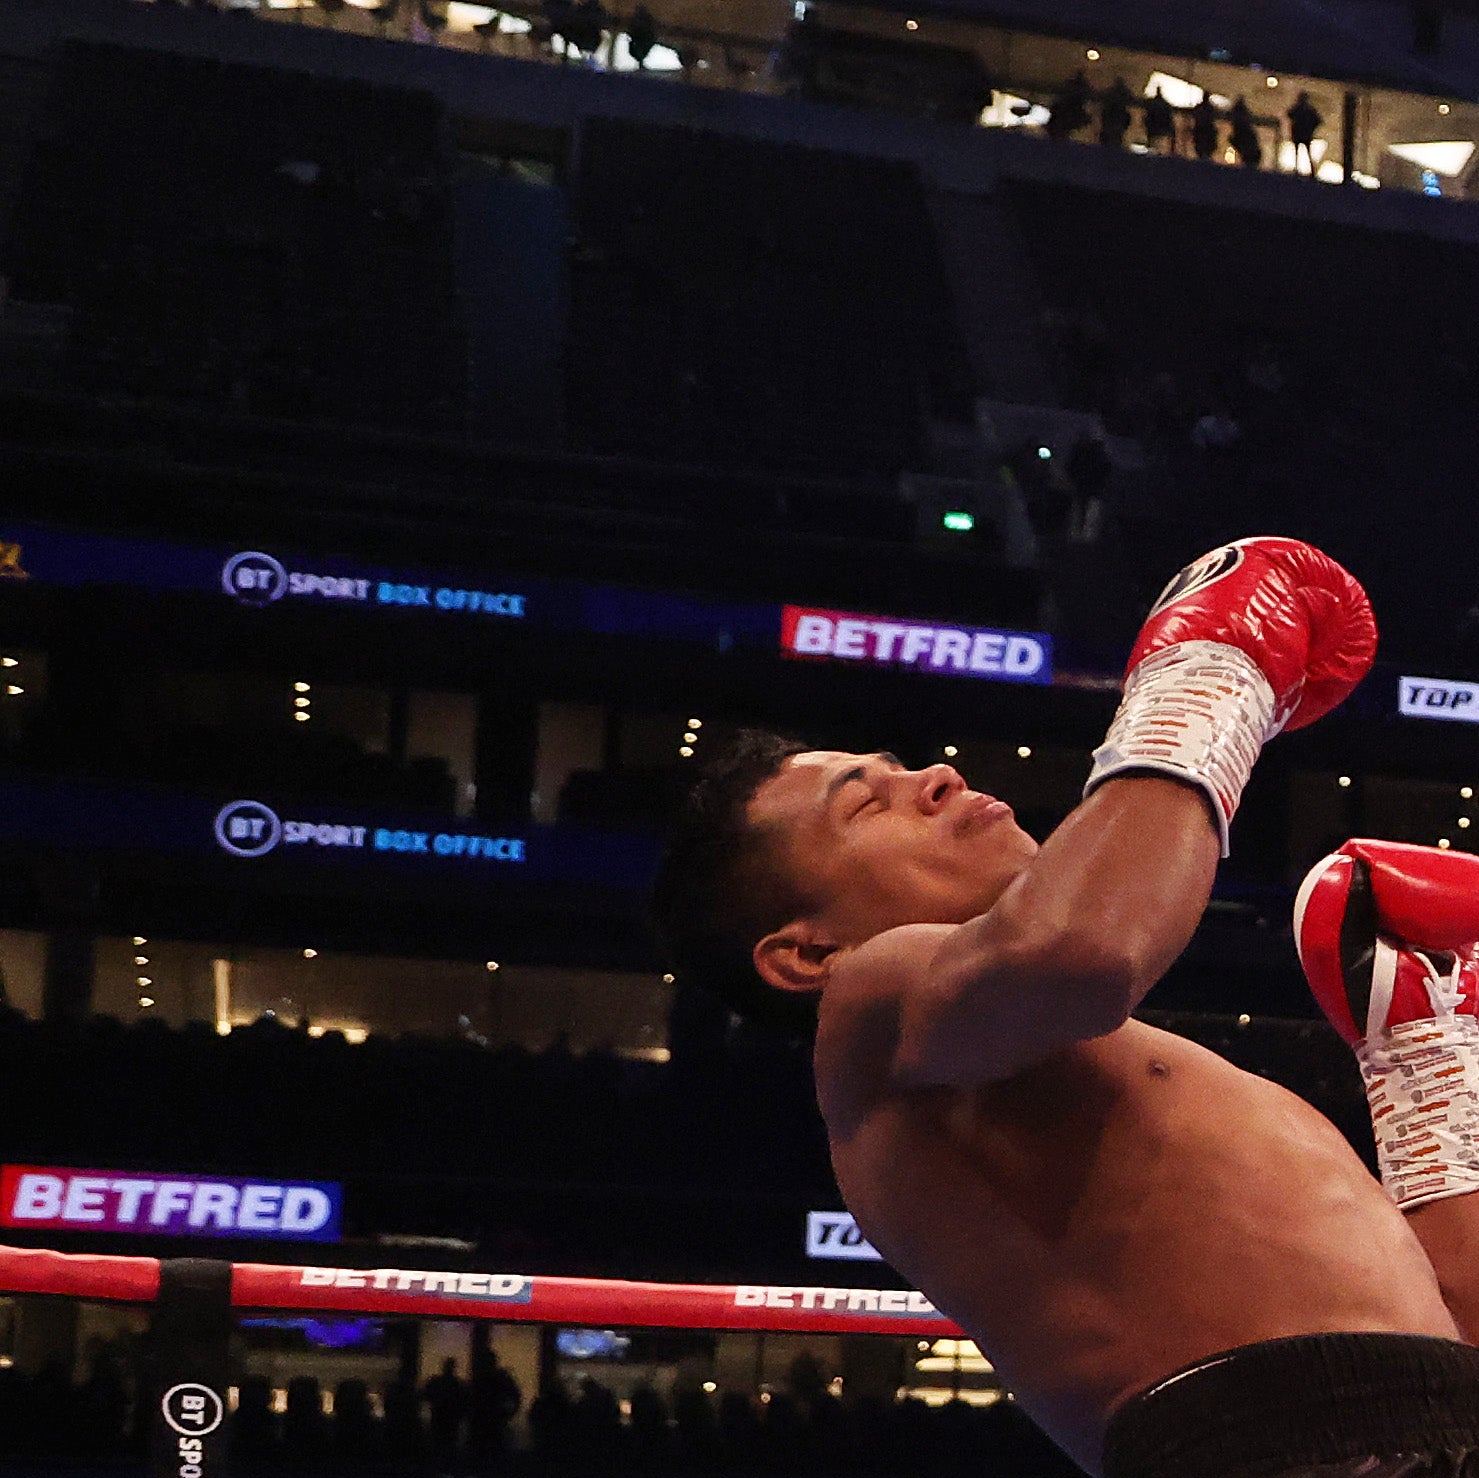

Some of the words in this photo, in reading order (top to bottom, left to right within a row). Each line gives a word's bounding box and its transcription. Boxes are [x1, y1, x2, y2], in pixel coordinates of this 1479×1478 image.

[235, 567, 272, 589] BT
[288, 571, 370, 599] SPORT
[376, 582, 429, 606] BOX
[794, 615, 1043, 676] BETFRED
[1406, 684, 1471, 710] TOP
[231, 816, 265, 839] BT
[284, 821, 364, 847] SPORT
[374, 828, 428, 852] BOX
[12, 1173, 331, 1234] BETFRED
[300, 1266, 525, 1298] BETFRED
[180, 1393, 206, 1424] BT
